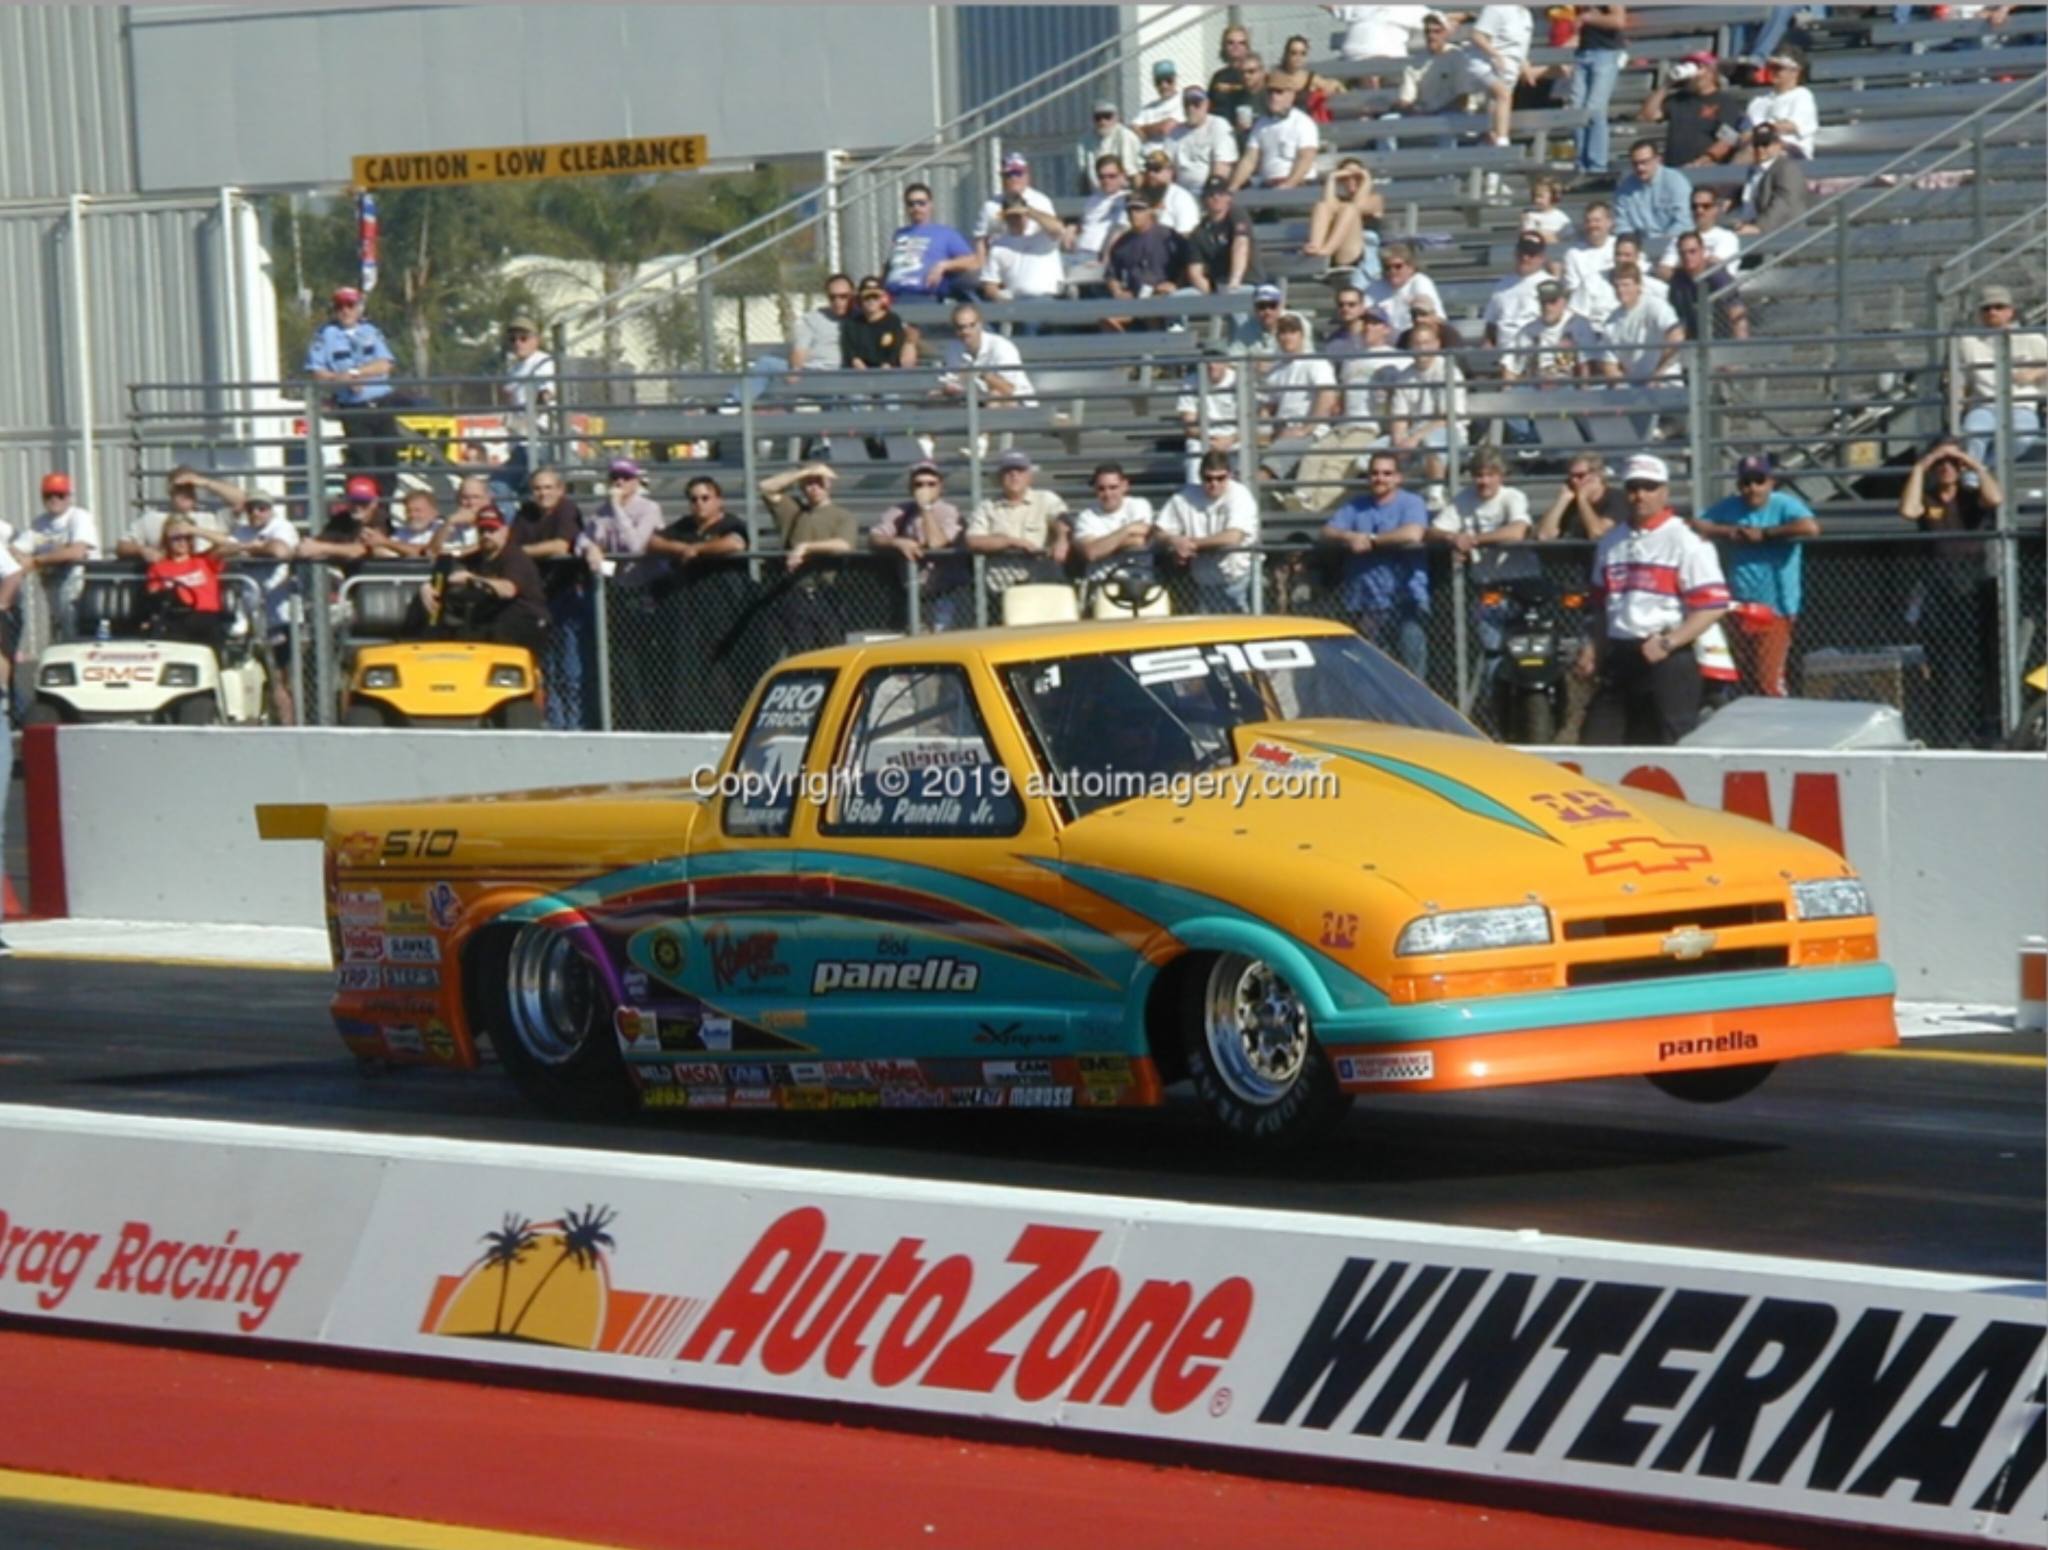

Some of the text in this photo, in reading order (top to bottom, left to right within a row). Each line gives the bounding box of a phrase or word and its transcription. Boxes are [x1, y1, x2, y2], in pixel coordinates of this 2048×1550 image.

[364, 154, 468, 184] CAUTION
[495, 148, 548, 176] LOW
[559, 138, 697, 173] CLEARANCE
[82, 667, 154, 682] GMC
[762, 683, 825, 710] PRO
[756, 711, 816, 729] TRUCK
[846, 797, 995, 825] Bob Panella Jr.
[381, 828, 458, 857] S10
[812, 957, 979, 996] panella
[1659, 1031, 1758, 1062] panella
[0, 1208, 302, 1332] rag Racing
[676, 1205, 1254, 1414] AutoZone
